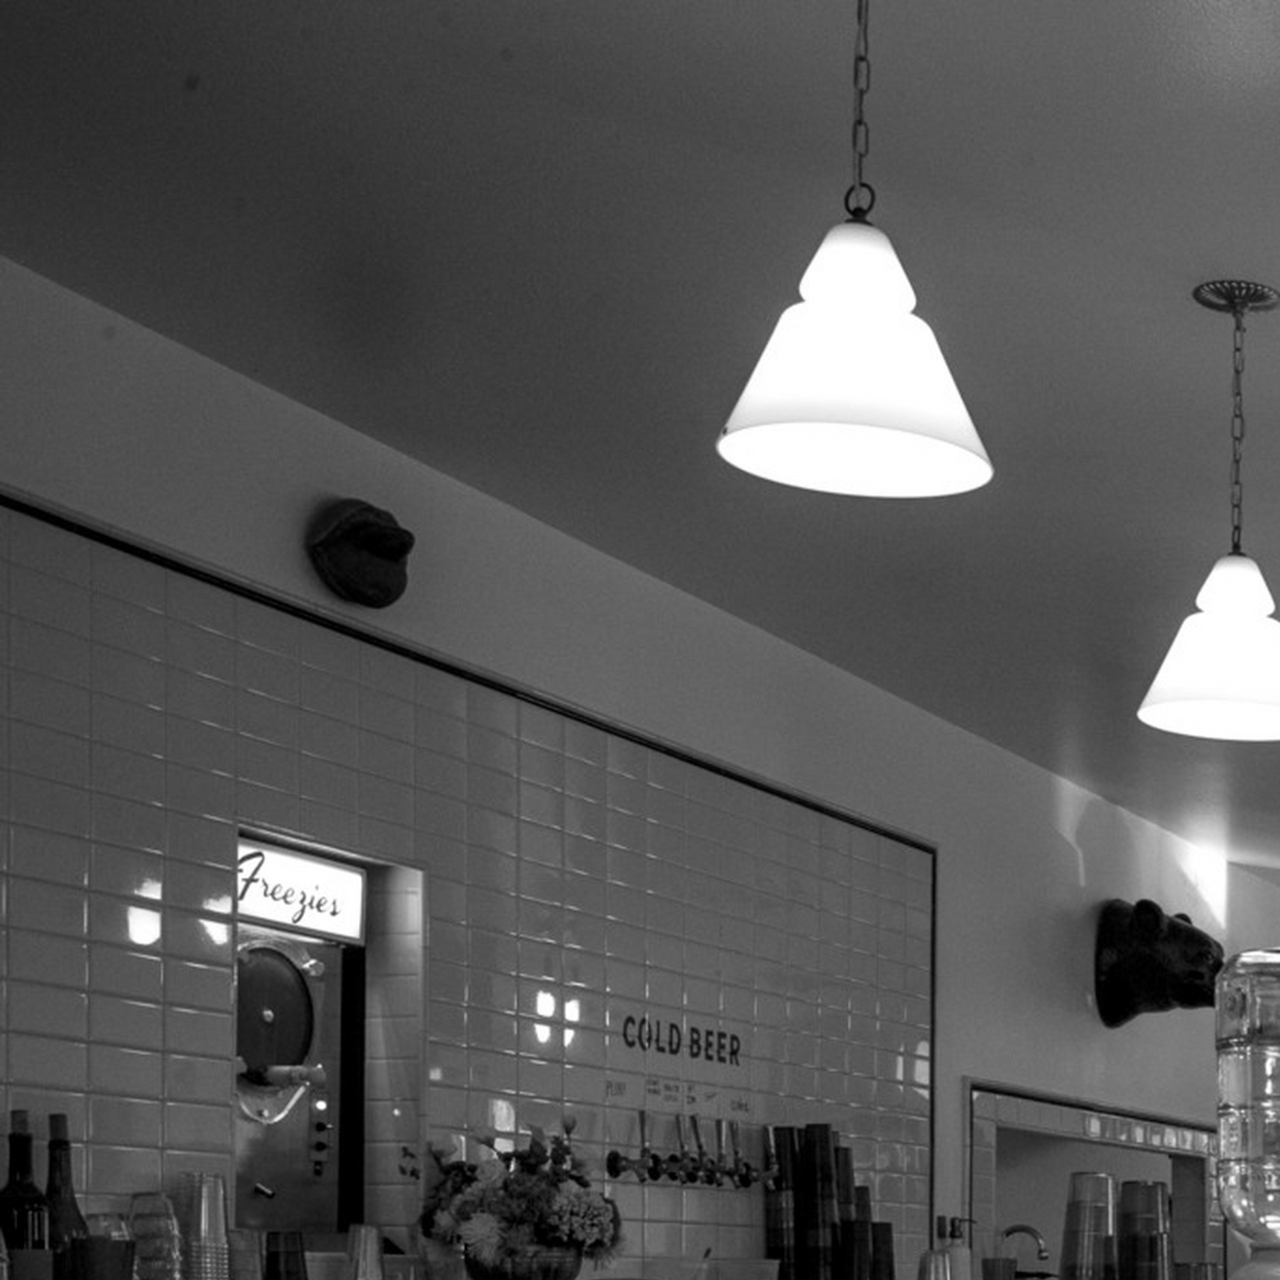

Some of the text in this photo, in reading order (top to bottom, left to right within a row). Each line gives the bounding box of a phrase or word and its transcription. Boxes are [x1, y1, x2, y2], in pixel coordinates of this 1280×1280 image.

[237, 851, 341, 924] Freezies
[622, 1015, 741, 1067] COLD BEER
